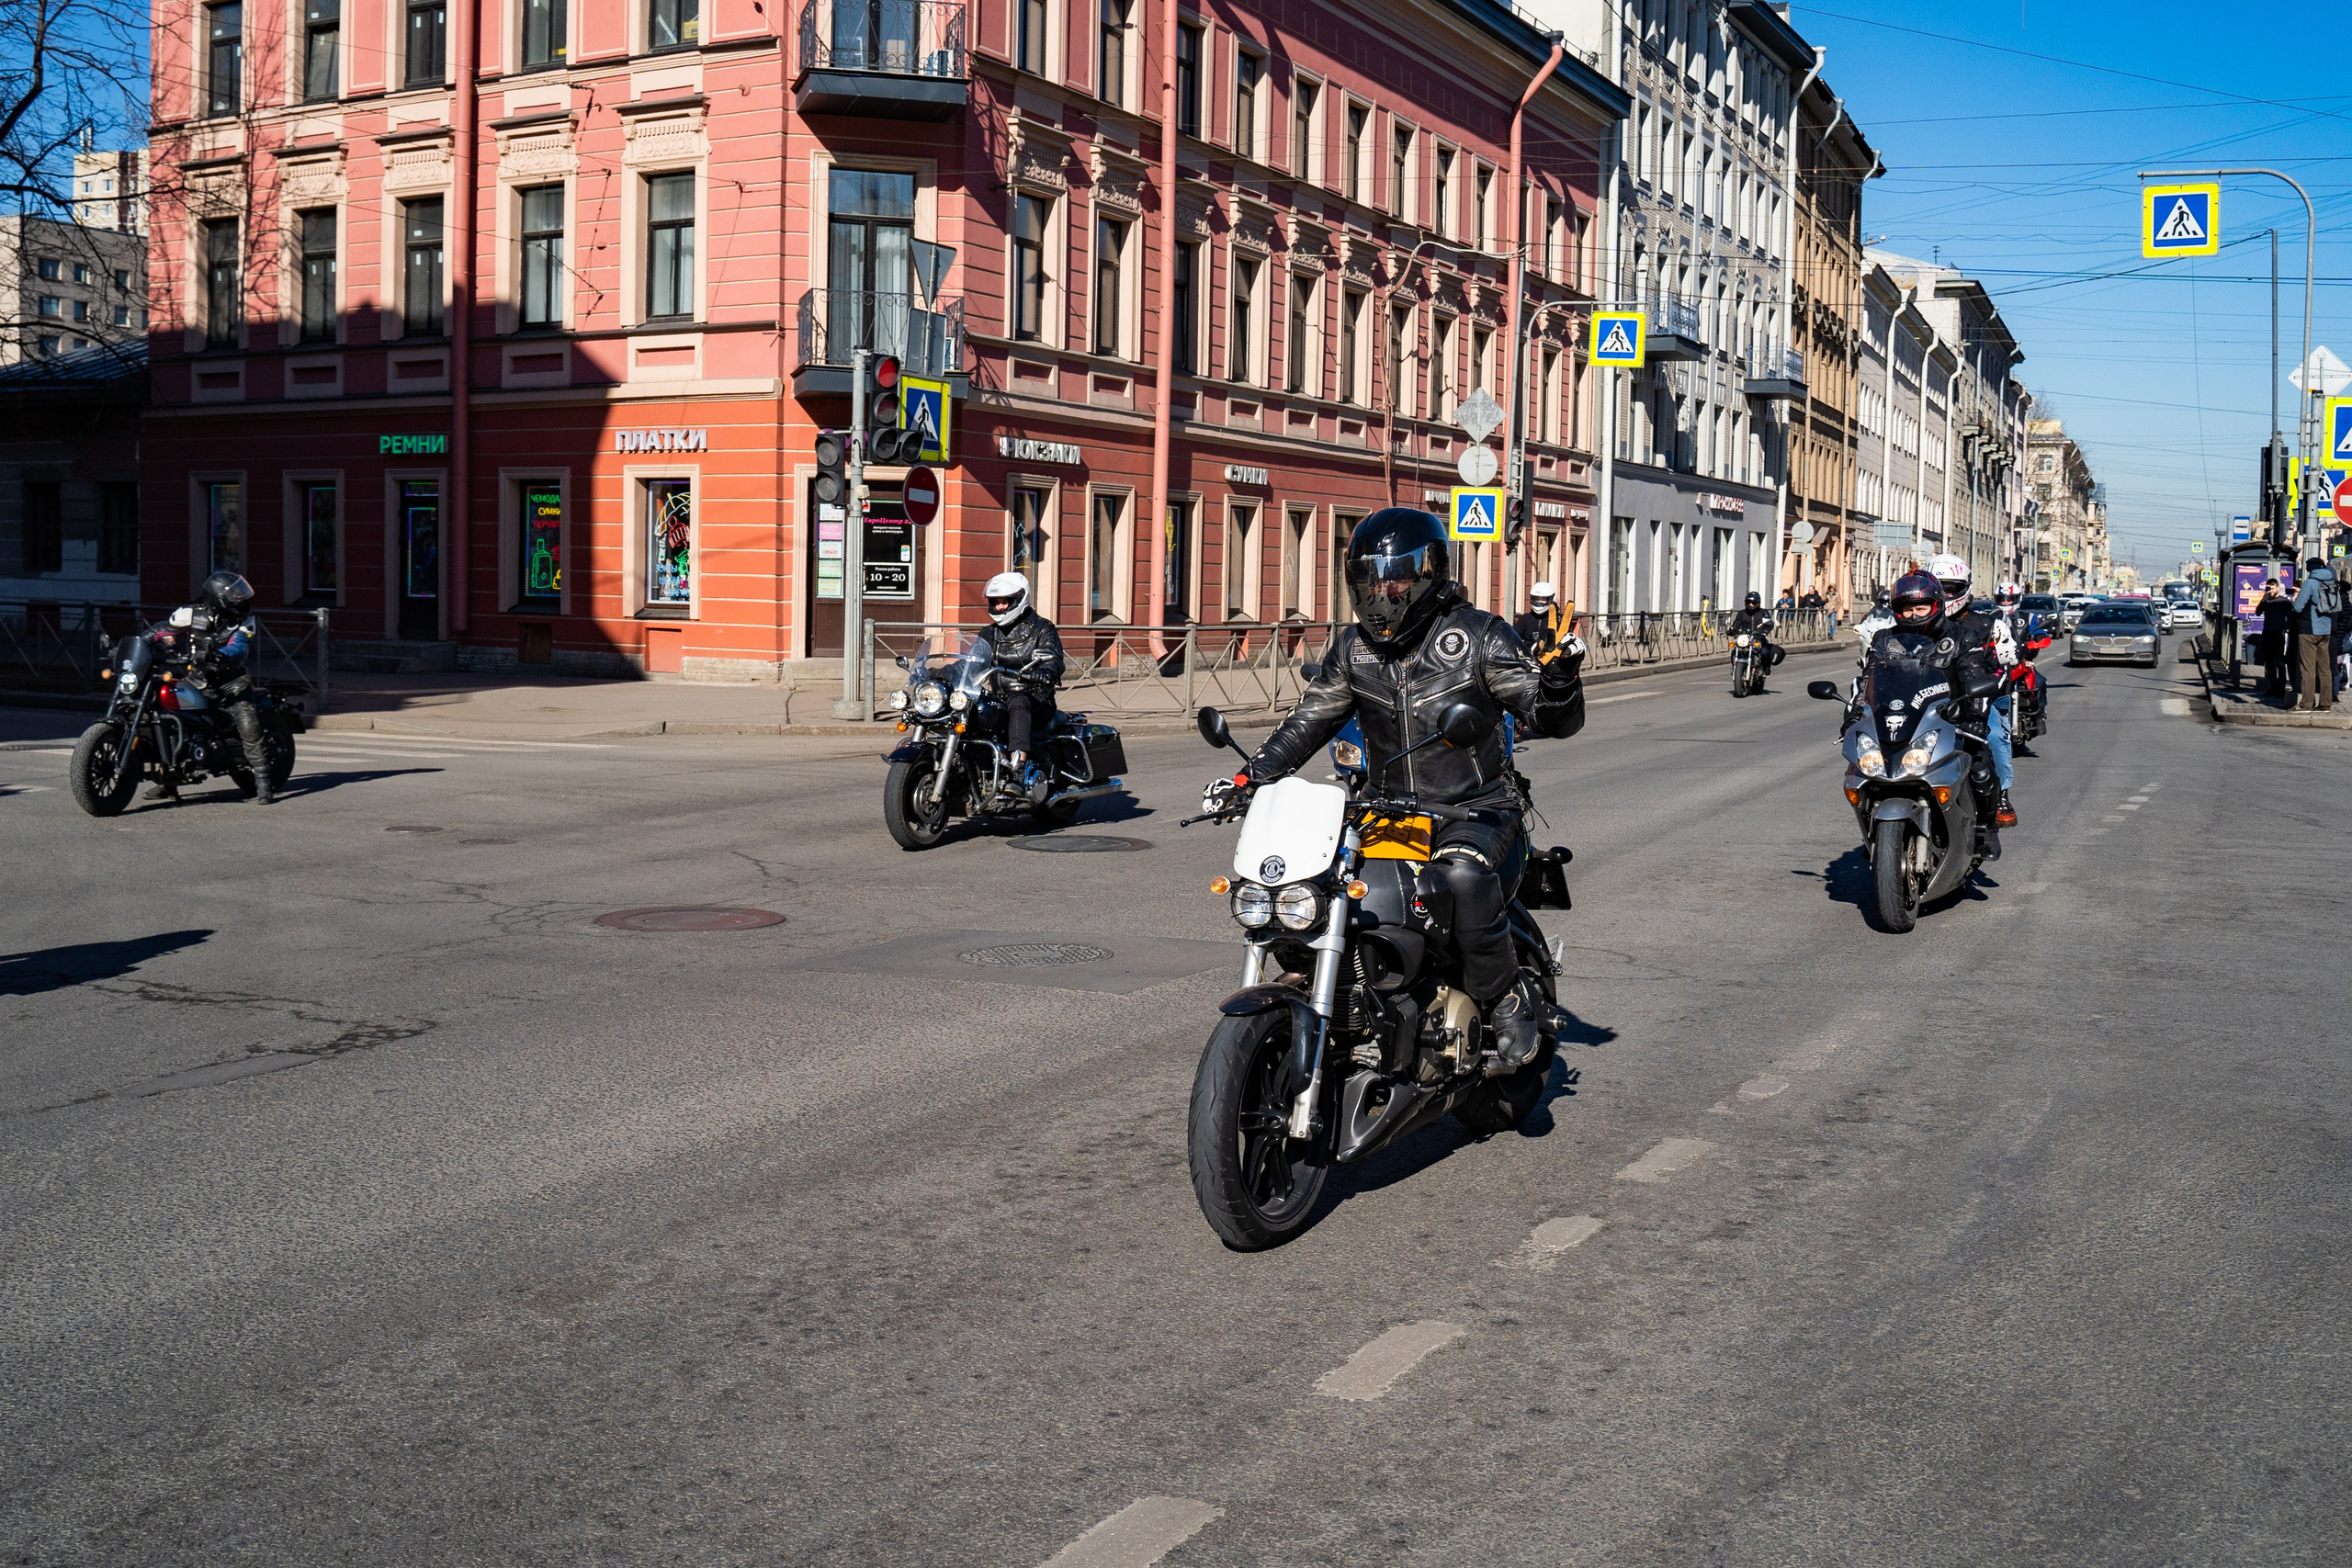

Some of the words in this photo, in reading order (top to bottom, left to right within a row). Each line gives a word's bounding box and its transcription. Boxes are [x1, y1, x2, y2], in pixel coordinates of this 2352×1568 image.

[379, 434, 445, 454] РЕМНИ
[616, 429, 707, 450] ПЛАТКИ
[1000, 436, 1080, 464] РЮКЗАКИ
[1225, 464, 1268, 485] СУМКИ
[870, 573, 882, 581] 10
[891, 573, 906, 581] 20
